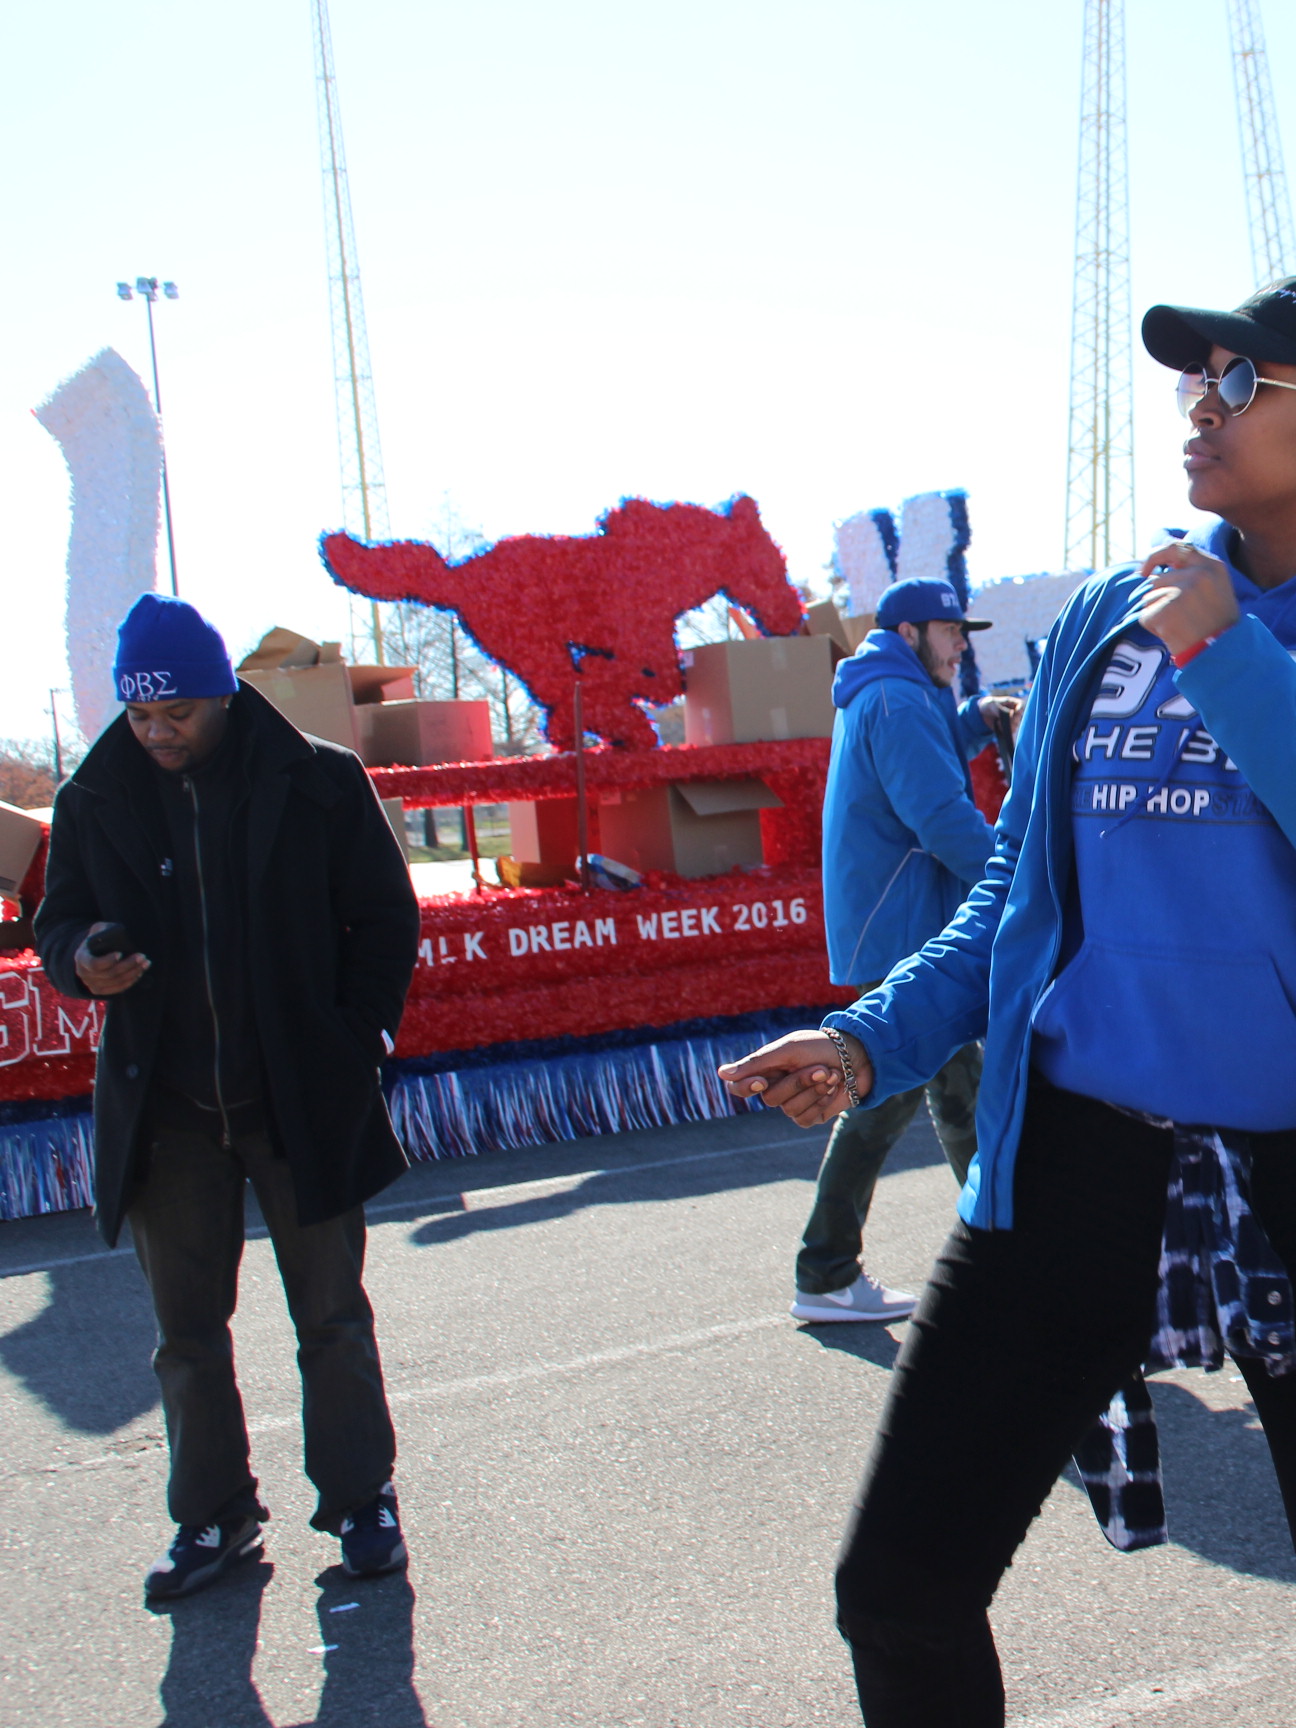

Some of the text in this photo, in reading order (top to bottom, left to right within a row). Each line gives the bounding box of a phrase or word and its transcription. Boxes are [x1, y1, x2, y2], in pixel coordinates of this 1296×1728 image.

[1073, 725, 1160, 763] HE
[1092, 783, 1137, 811] HIP
[1146, 786, 1210, 816] HOP
[508, 917, 617, 957] DREAM
[636, 906, 723, 941] WEEK
[732, 898, 807, 931] 2016
